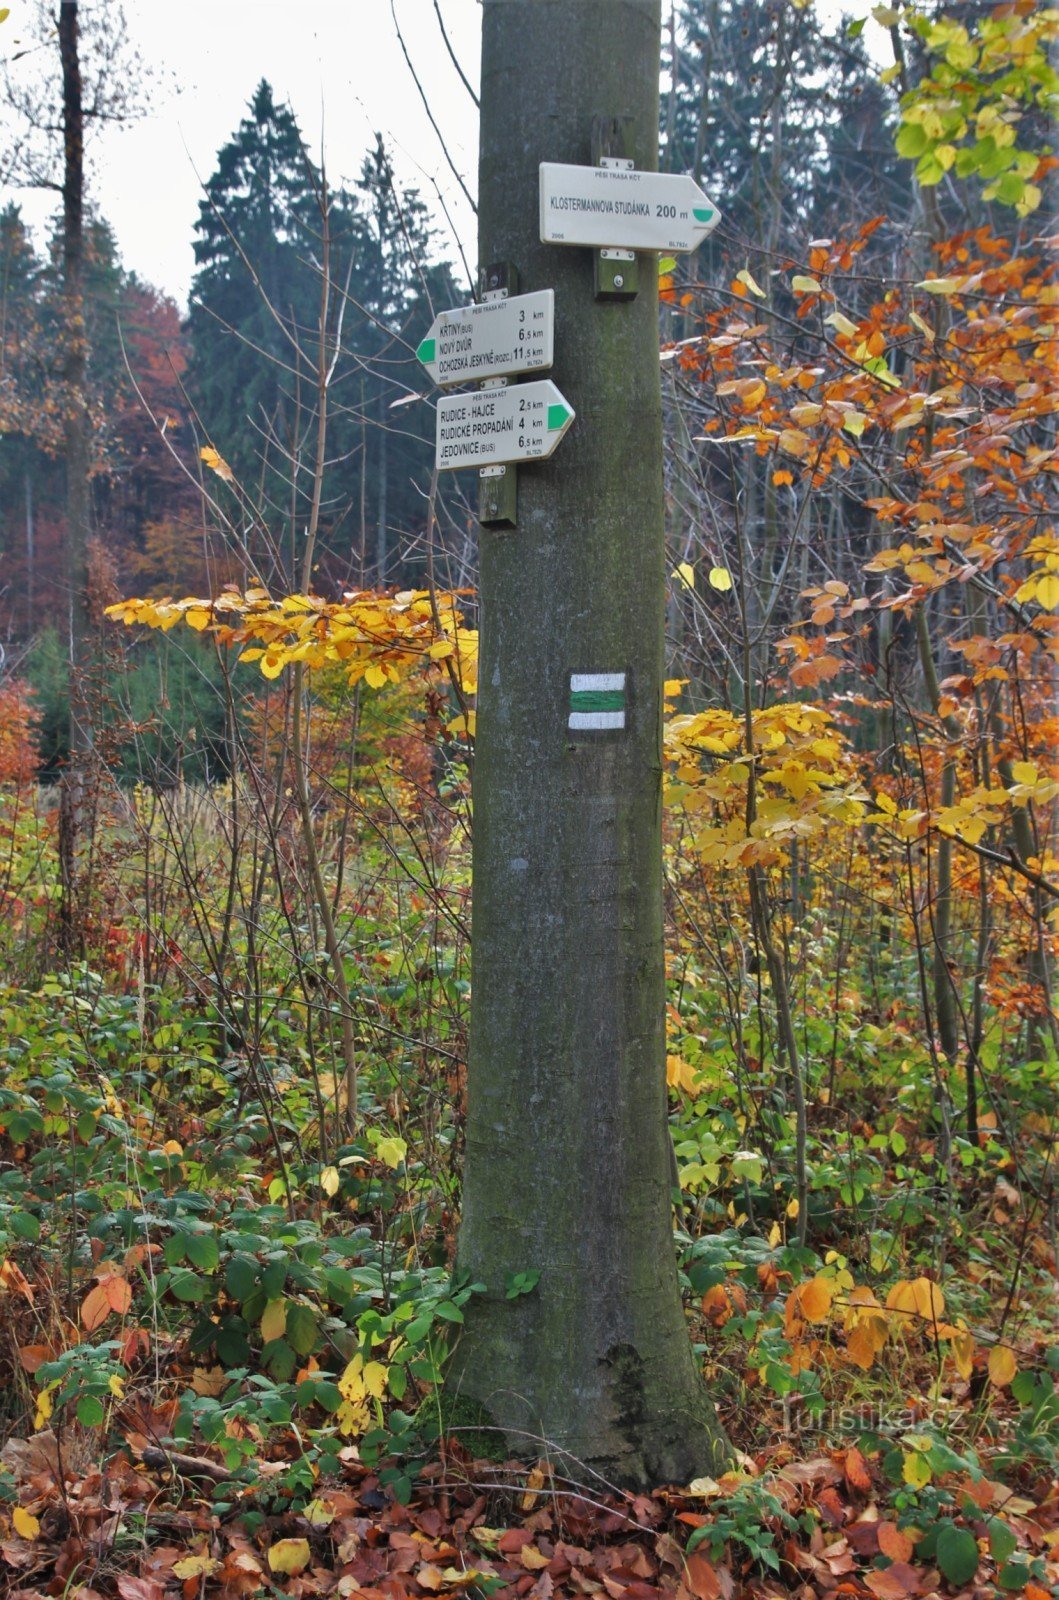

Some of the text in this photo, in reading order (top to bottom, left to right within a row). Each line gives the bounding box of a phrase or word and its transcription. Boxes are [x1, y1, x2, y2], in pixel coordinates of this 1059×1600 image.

[550, 197, 613, 214] KLOSTERMANNOVA
[614, 200, 650, 216] STUDÁNKA
[656, 205, 676, 218] 200
[440, 322, 461, 338] KŘTINY
[519, 310, 525, 322] 3
[533, 311, 544, 320] km
[440, 328, 543, 356] NOVÝ DVŮR 6,5 km
[439, 356, 468, 373] OCHOZSKÁ
[469, 348, 494, 370] JESKYNĚ
[513, 347, 531, 360] 11,5
[532, 348, 543, 357] km
[441, 407, 466, 423] RUDICE
[471, 403, 495, 418] HAJCE
[519, 398, 531, 412] 2,5
[533, 400, 543, 409] km
[441, 416, 543, 438] RUDICKÉ PROPADÁNÍ 4 km
[440, 435, 542, 458] JEDOVNICE (BUS) 6,5 km
